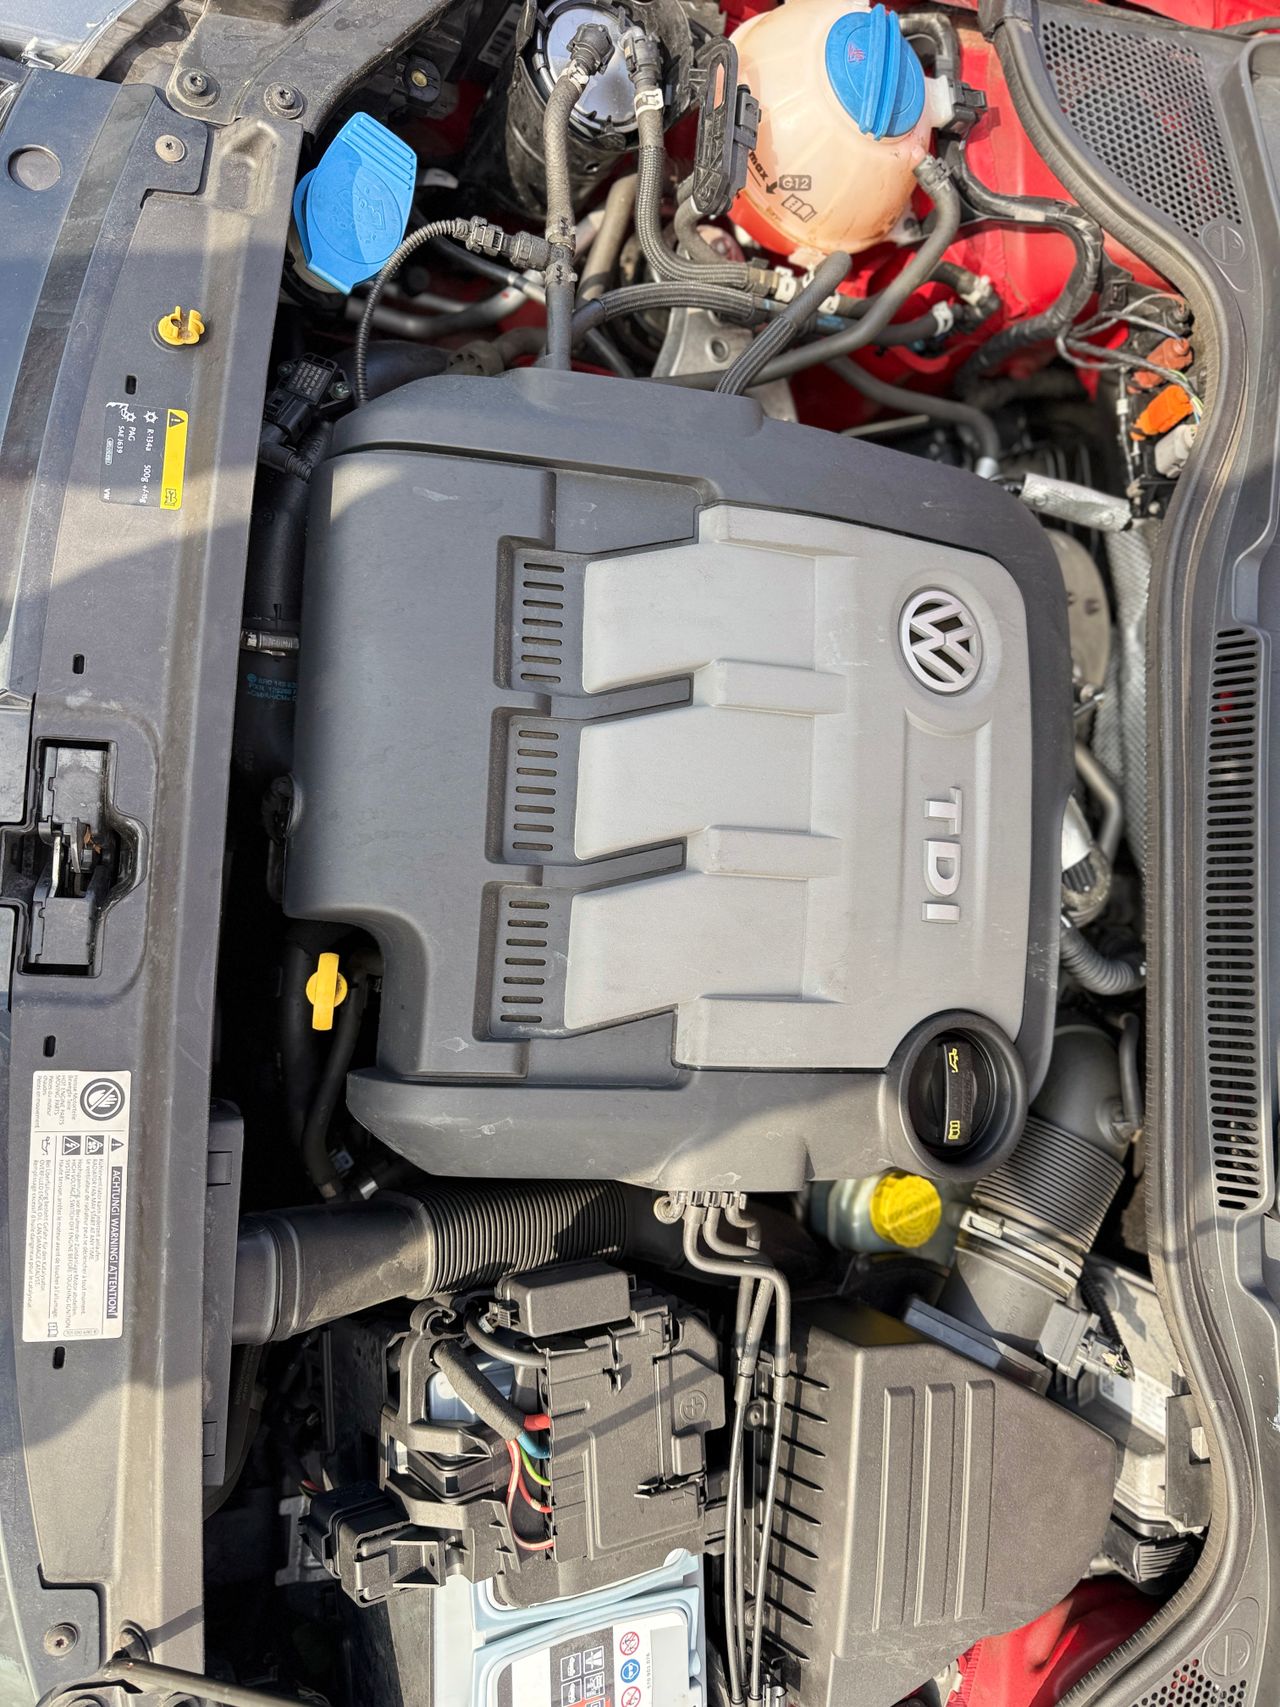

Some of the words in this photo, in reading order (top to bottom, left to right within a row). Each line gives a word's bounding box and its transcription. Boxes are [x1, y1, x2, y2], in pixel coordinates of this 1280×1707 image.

[749, 151, 768, 180] max
[782, 176, 810, 190] G12
[128, 427, 136, 441] PAG
[146, 429, 154, 451] R-134a
[141, 464, 151, 482] 500g
[104, 488, 111, 500] VW
[899, 588, 981, 695] VW
[922, 787, 963, 925] TDI
[112, 1170, 120, 1215] ACHTUNG!
[110, 1218, 120, 1263] WARNING!
[108, 1265, 118, 1315] ATTENTION!
